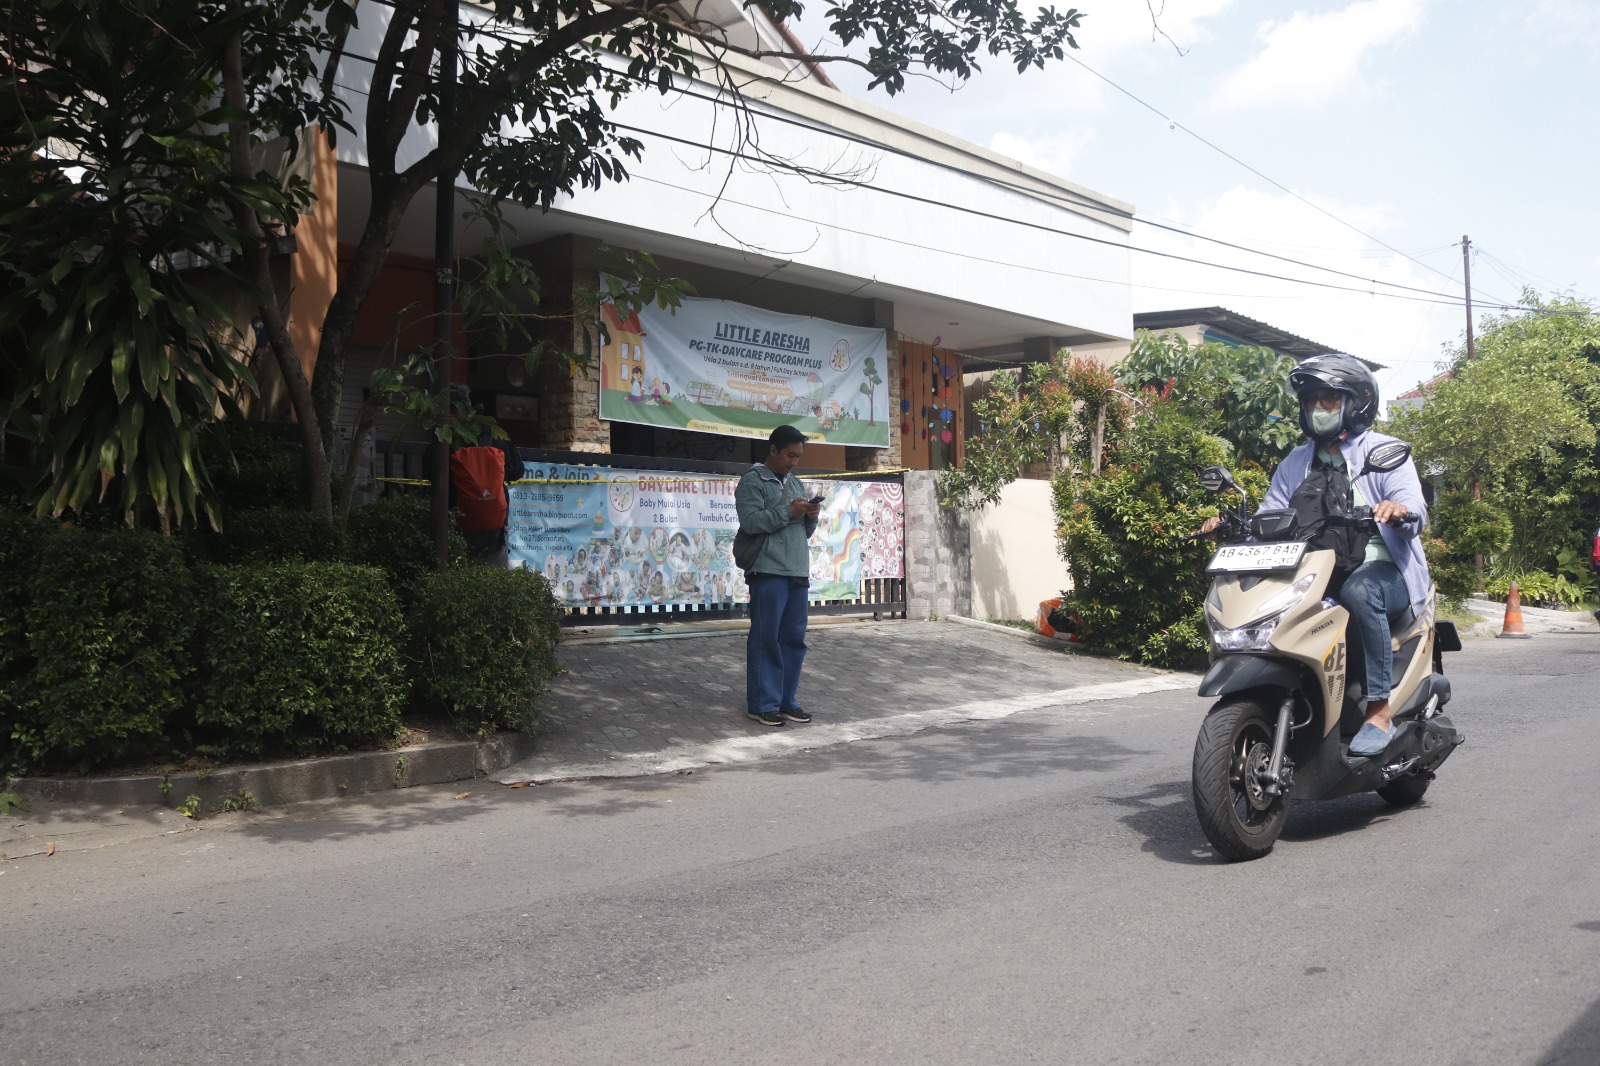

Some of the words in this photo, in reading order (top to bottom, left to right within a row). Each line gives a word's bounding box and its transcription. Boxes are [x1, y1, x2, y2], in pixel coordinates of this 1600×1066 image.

[716, 322, 761, 344] LITTLE
[762, 331, 810, 351] ARESHA
[689, 339, 763, 361] PG-TK-DAYCARE
[764, 352, 804, 367] PROGRAM
[804, 359, 822, 370] PLUS
[703, 355, 717, 364] Usia
[717, 357, 722, 365] 2
[722, 358, 740, 367] bulan
[755, 363, 771, 373] tahun
[783, 367, 793, 377] Day
[549, 466, 560, 482] &
[638, 475, 698, 494] DAYCARE
[639, 498, 656, 510] Baby
[657, 499, 676, 509] Mulai
[676, 499, 691, 509] Usia
[653, 513, 658, 523] 2
[660, 514, 678, 523] Bulan
[698, 513, 724, 523] Tumbuh
[1219, 548, 1236, 559] AB
[1311, 619, 1334, 635] HONDA
